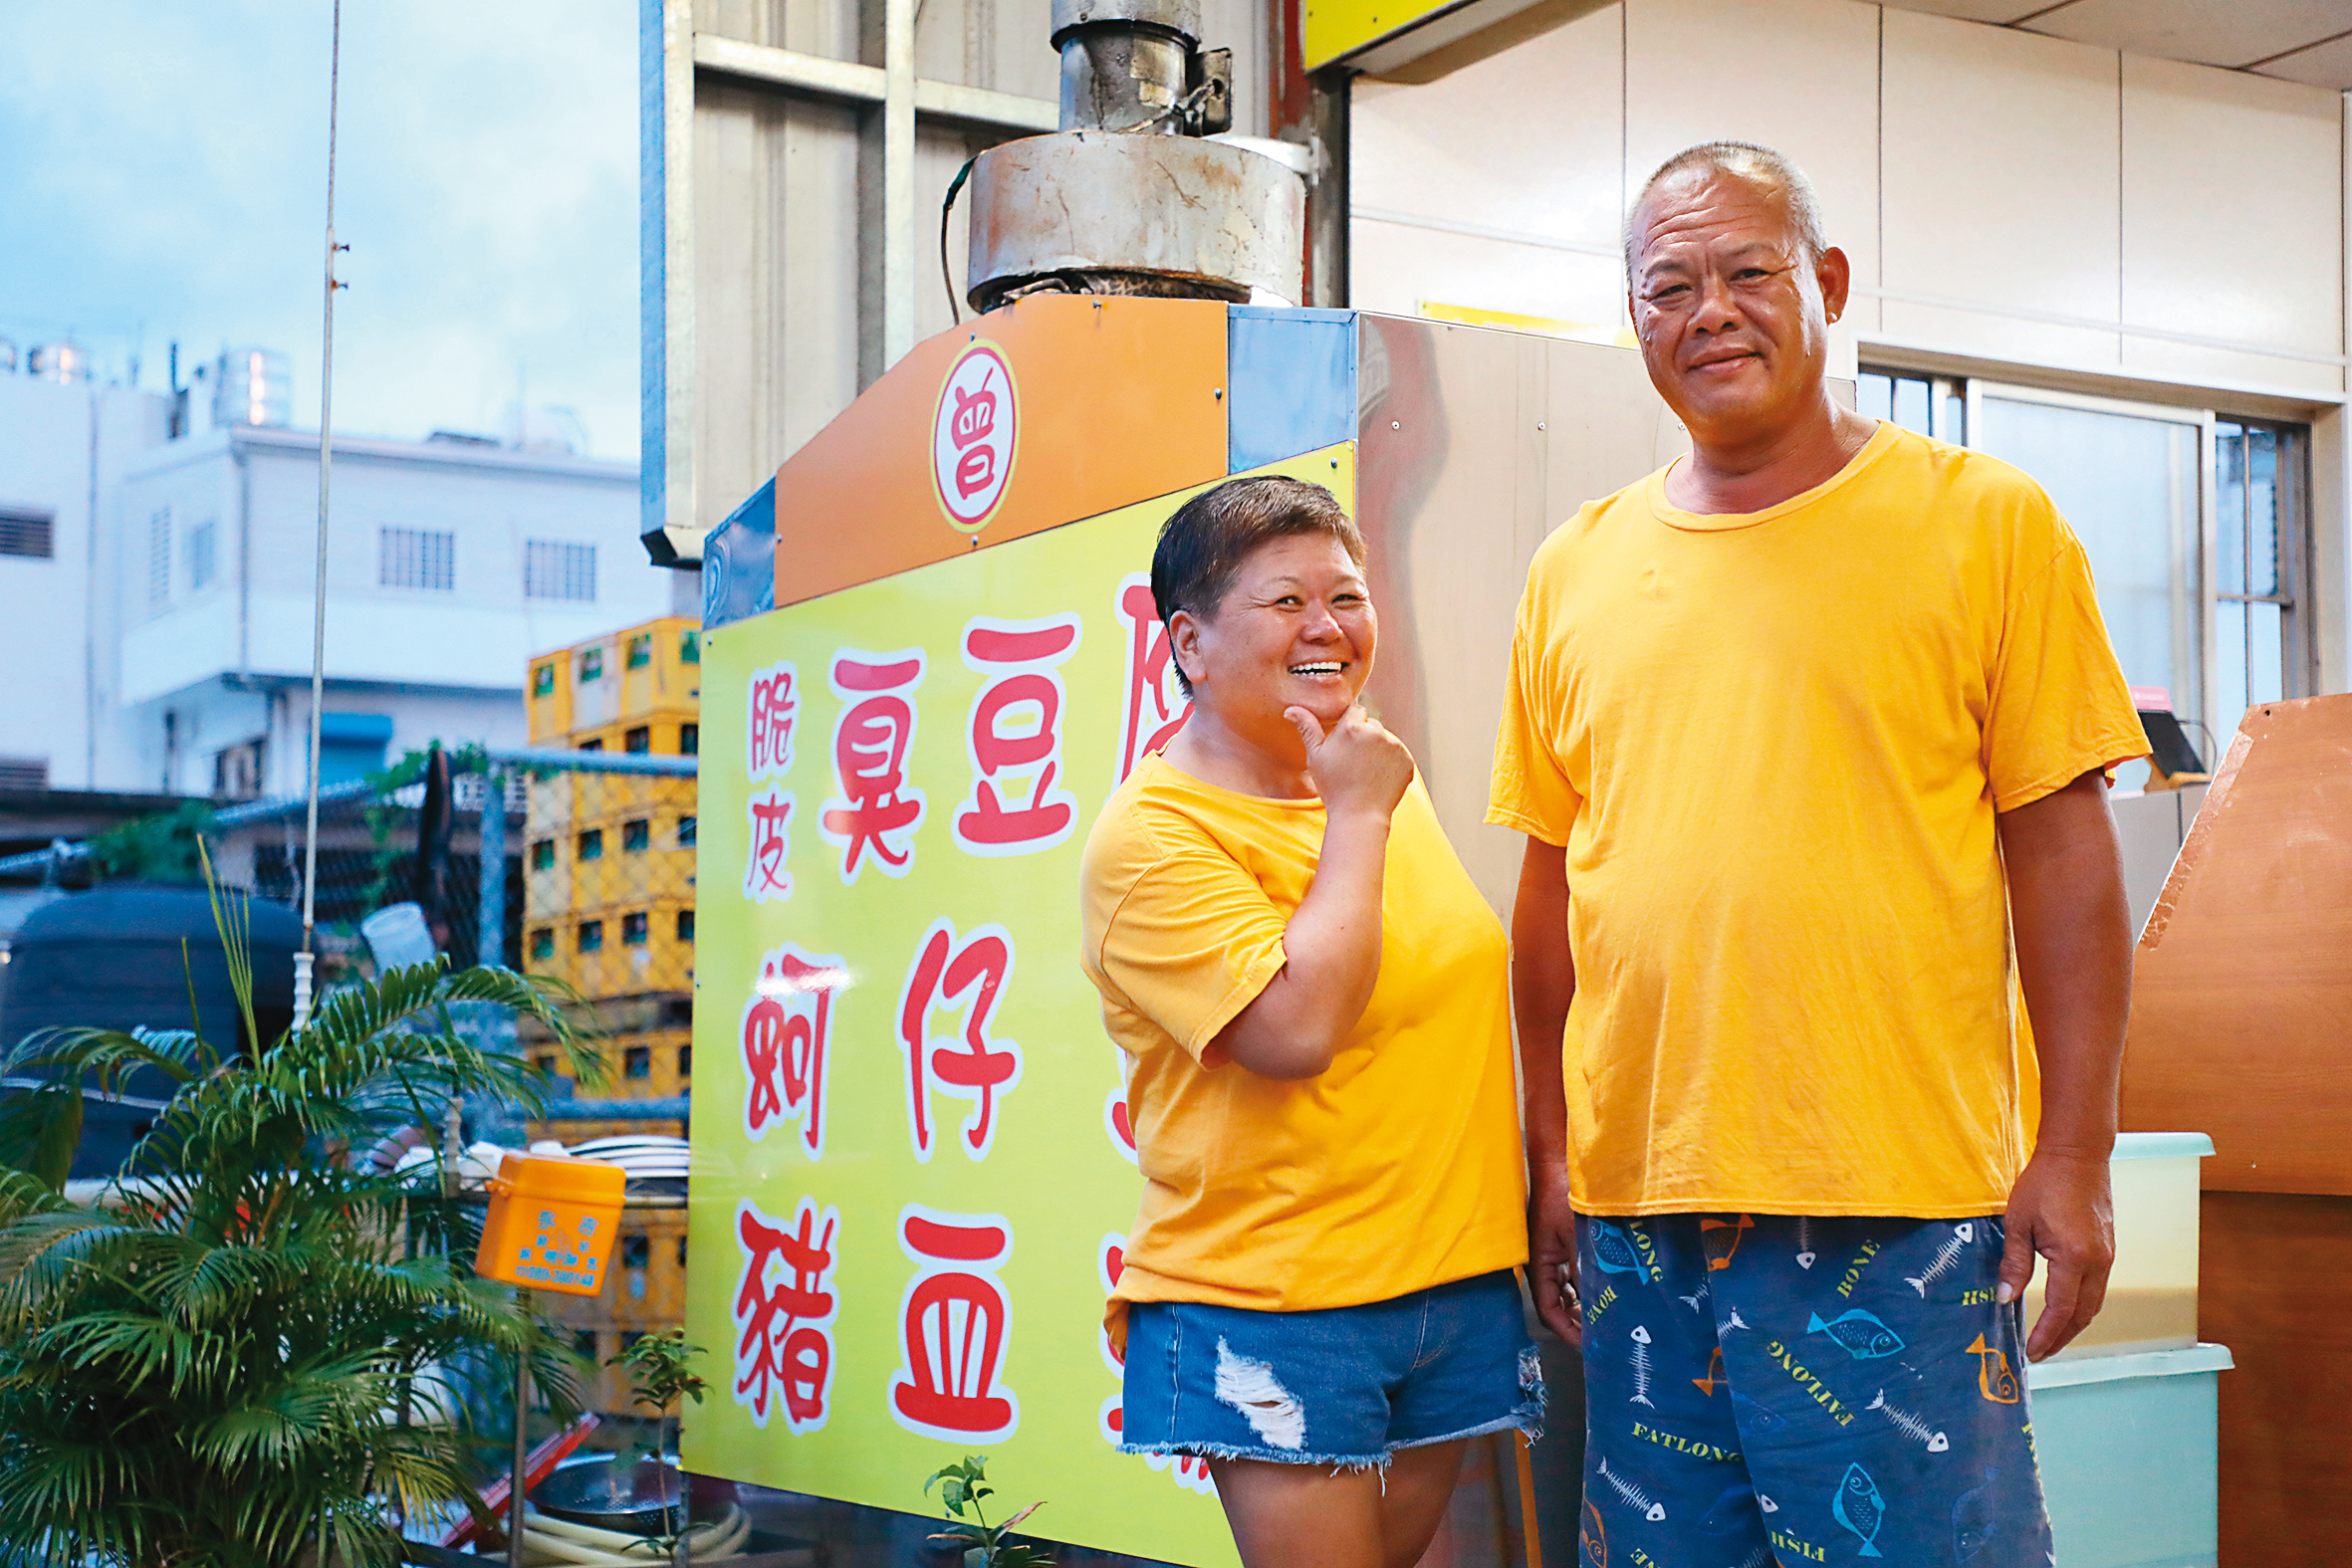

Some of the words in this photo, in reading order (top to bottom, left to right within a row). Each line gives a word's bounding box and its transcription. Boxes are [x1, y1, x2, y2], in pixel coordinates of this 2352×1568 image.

[745, 929, 1137, 1151] 蚵仔
[1837, 1238, 1881, 1297] BONE
[1765, 1340, 1854, 1427] FATLONG
[1770, 1530, 1825, 1562] FISH
